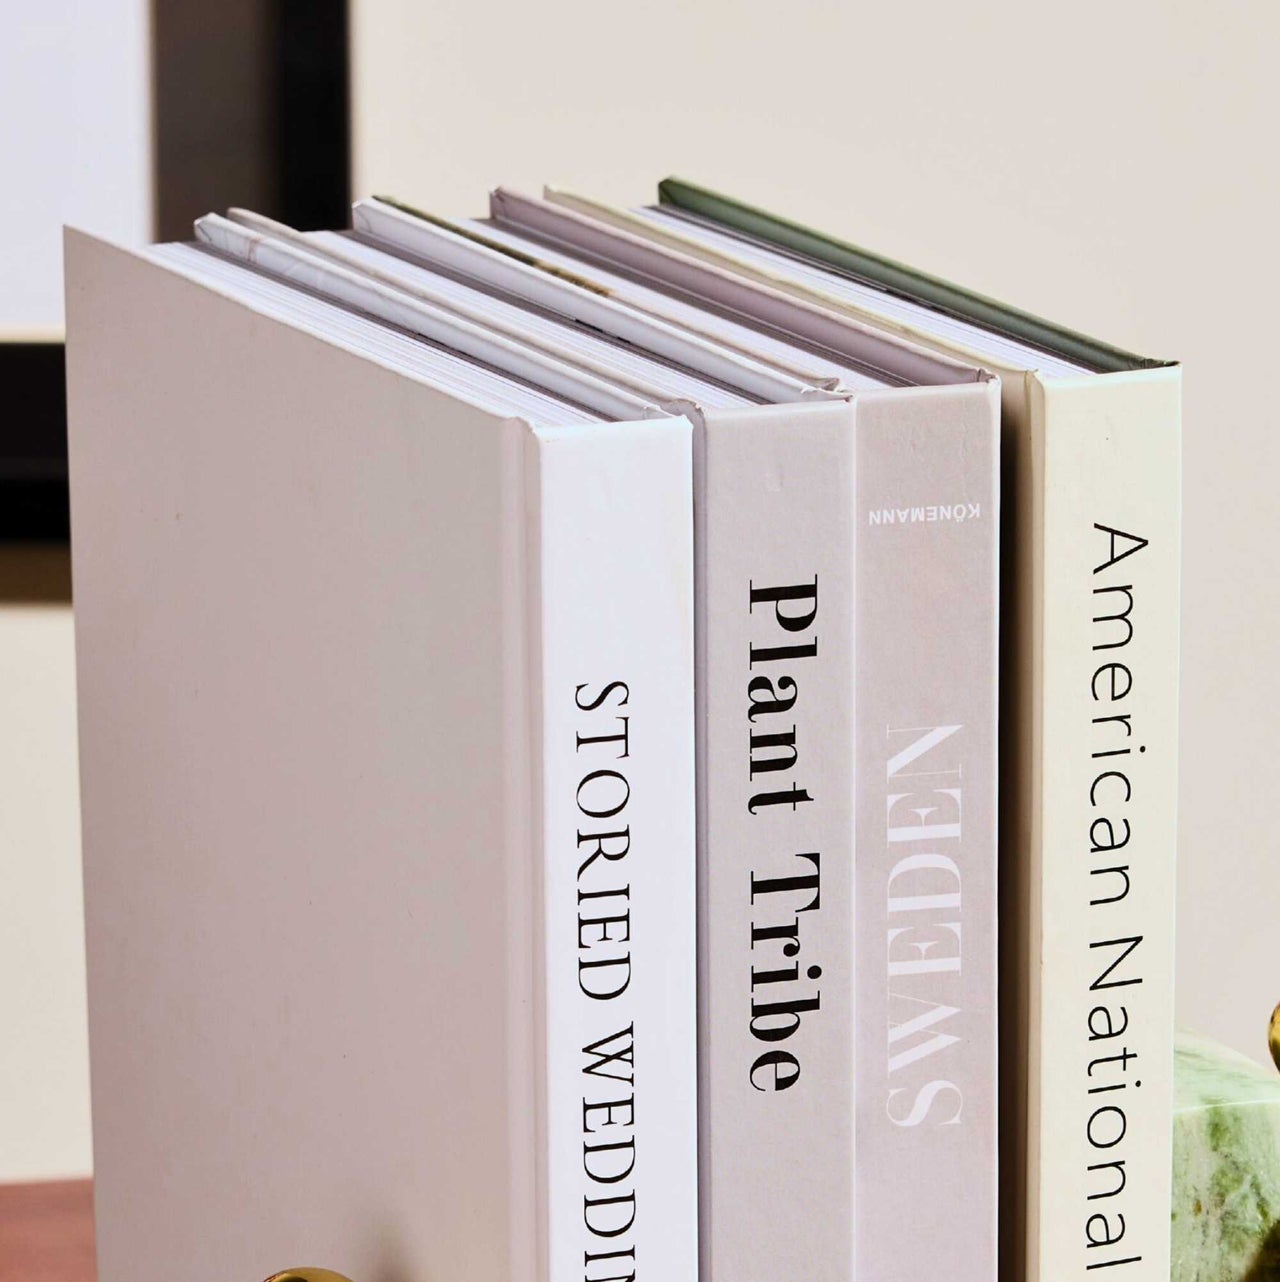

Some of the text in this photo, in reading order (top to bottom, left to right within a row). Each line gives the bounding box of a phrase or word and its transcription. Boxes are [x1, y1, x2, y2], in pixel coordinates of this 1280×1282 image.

[868, 503, 981, 526] KÖNEMANN
[575, 681, 631, 1000] STORIED
[748, 574, 822, 1091] Plant Tribe
[1090, 523, 1148, 905] American
[887, 724, 963, 1126] SWEDEN
[1086, 936, 1143, 1270] National
